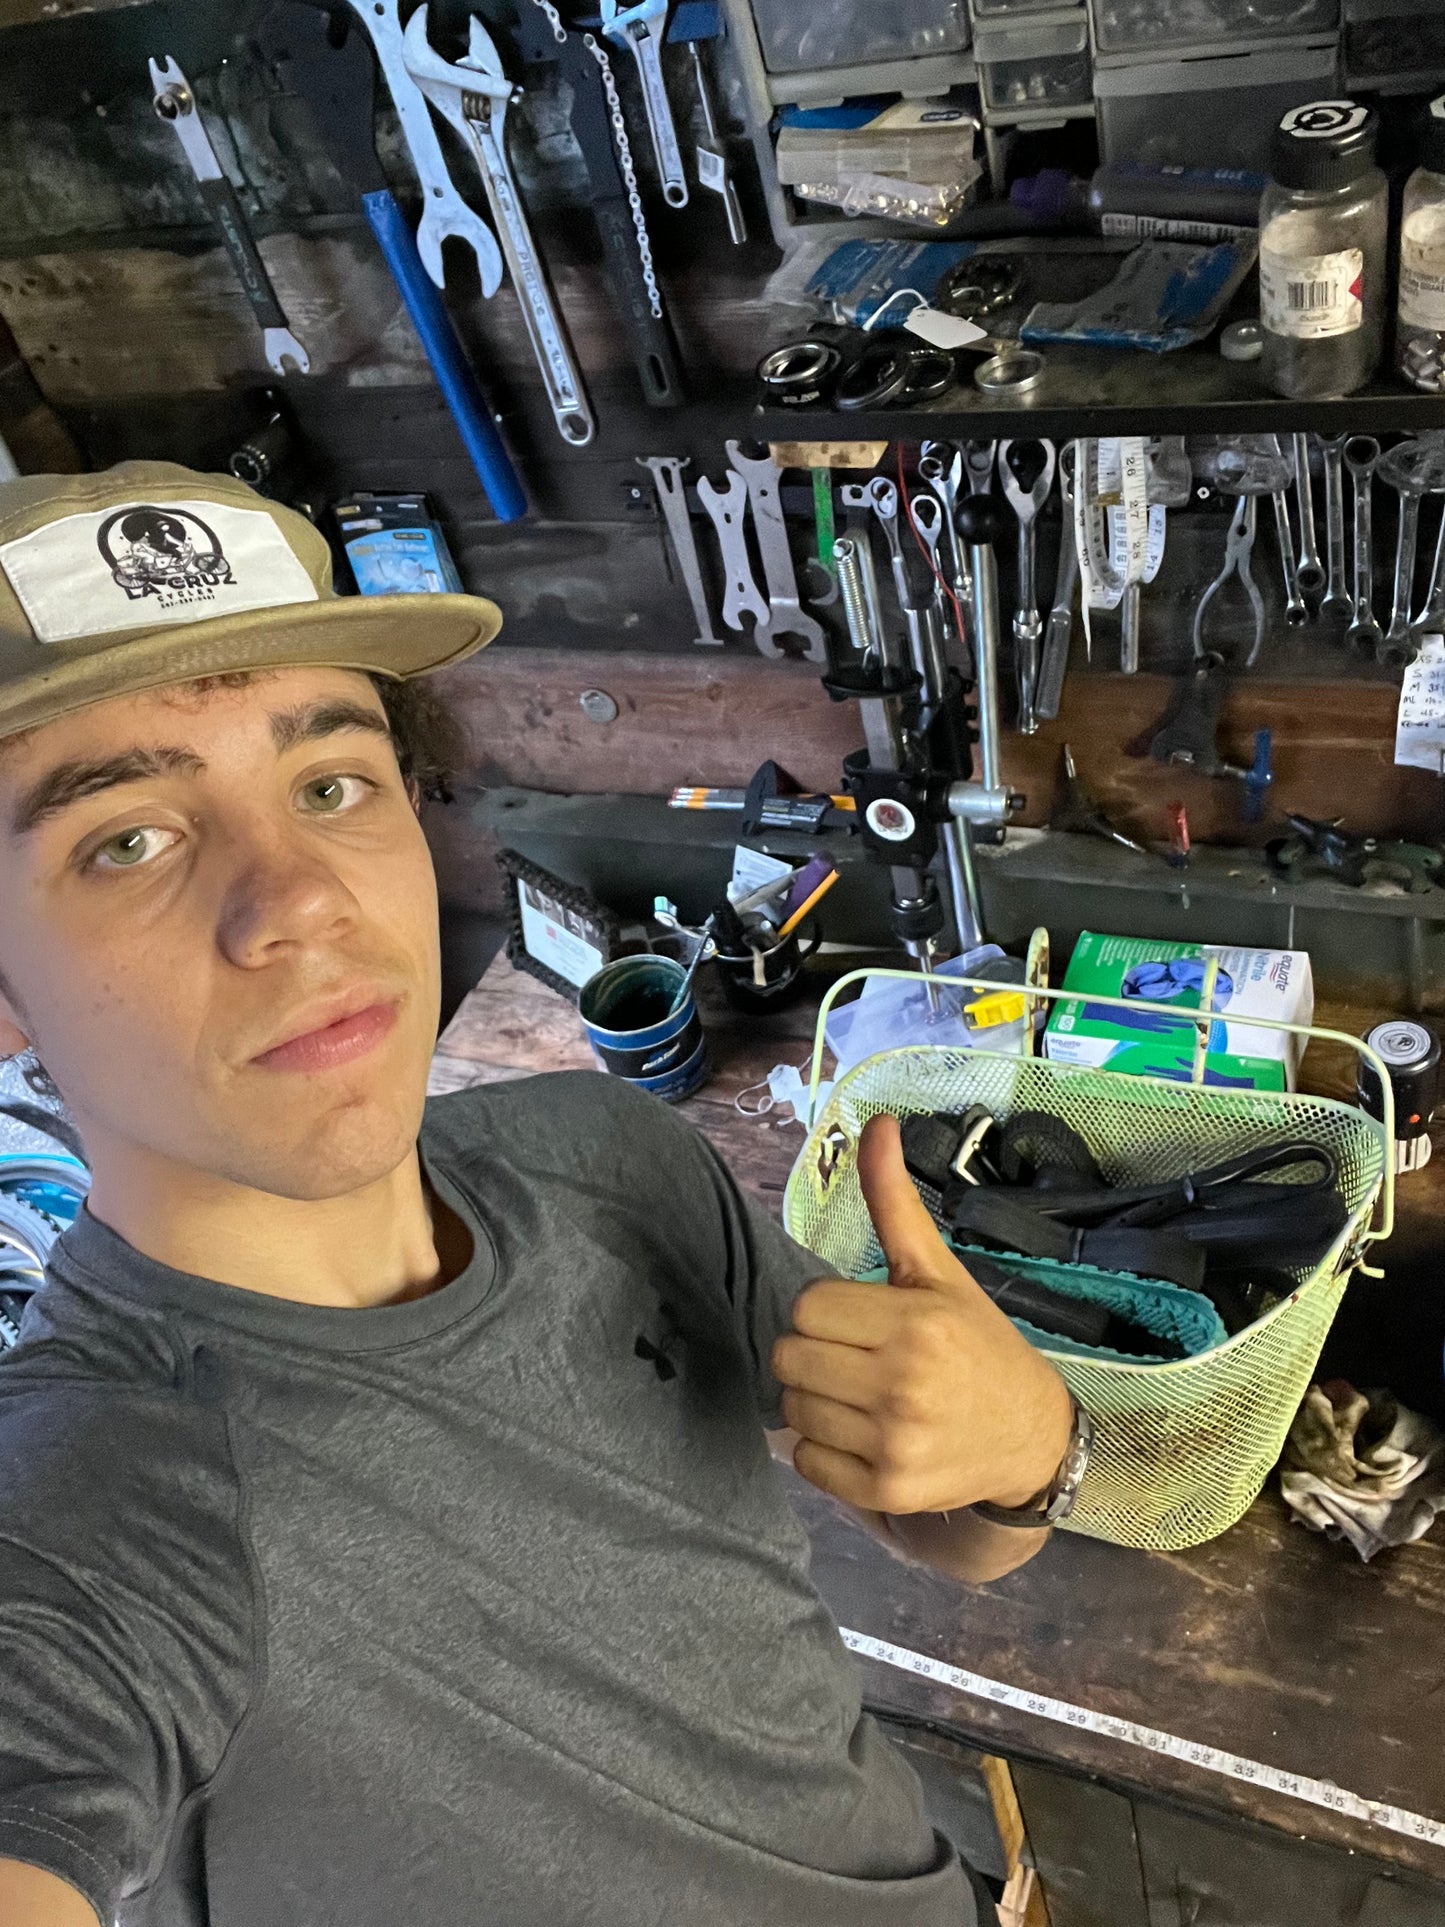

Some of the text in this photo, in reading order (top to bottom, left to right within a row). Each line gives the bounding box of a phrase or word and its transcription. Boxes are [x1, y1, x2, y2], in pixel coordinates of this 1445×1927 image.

[1126, 457, 1137, 477] 26
[1130, 500, 1139, 518] 27
[1132, 542, 1141, 560] 28
[125, 572, 238, 600] LA CRUZ
[1409, 682, 1420, 692] M
[1251, 951, 1272, 982] Nitrile
[1275, 954, 1293, 992] equate
[876, 1648, 894, 1661] 24
[913, 1661, 931, 1674] 25
[951, 1674, 970, 1687] 26
[1027, 1700, 1046, 1713] 28
[1066, 1711, 1087, 1724] 29
[1149, 1737, 1168, 1750] 31
[1190, 1751, 1212, 1764] 32
[1233, 1764, 1255, 1778] 33
[1278, 1778, 1299, 1792] 34
[1323, 1792, 1345, 1807] 35
[1415, 1823, 1440, 1838] 37
